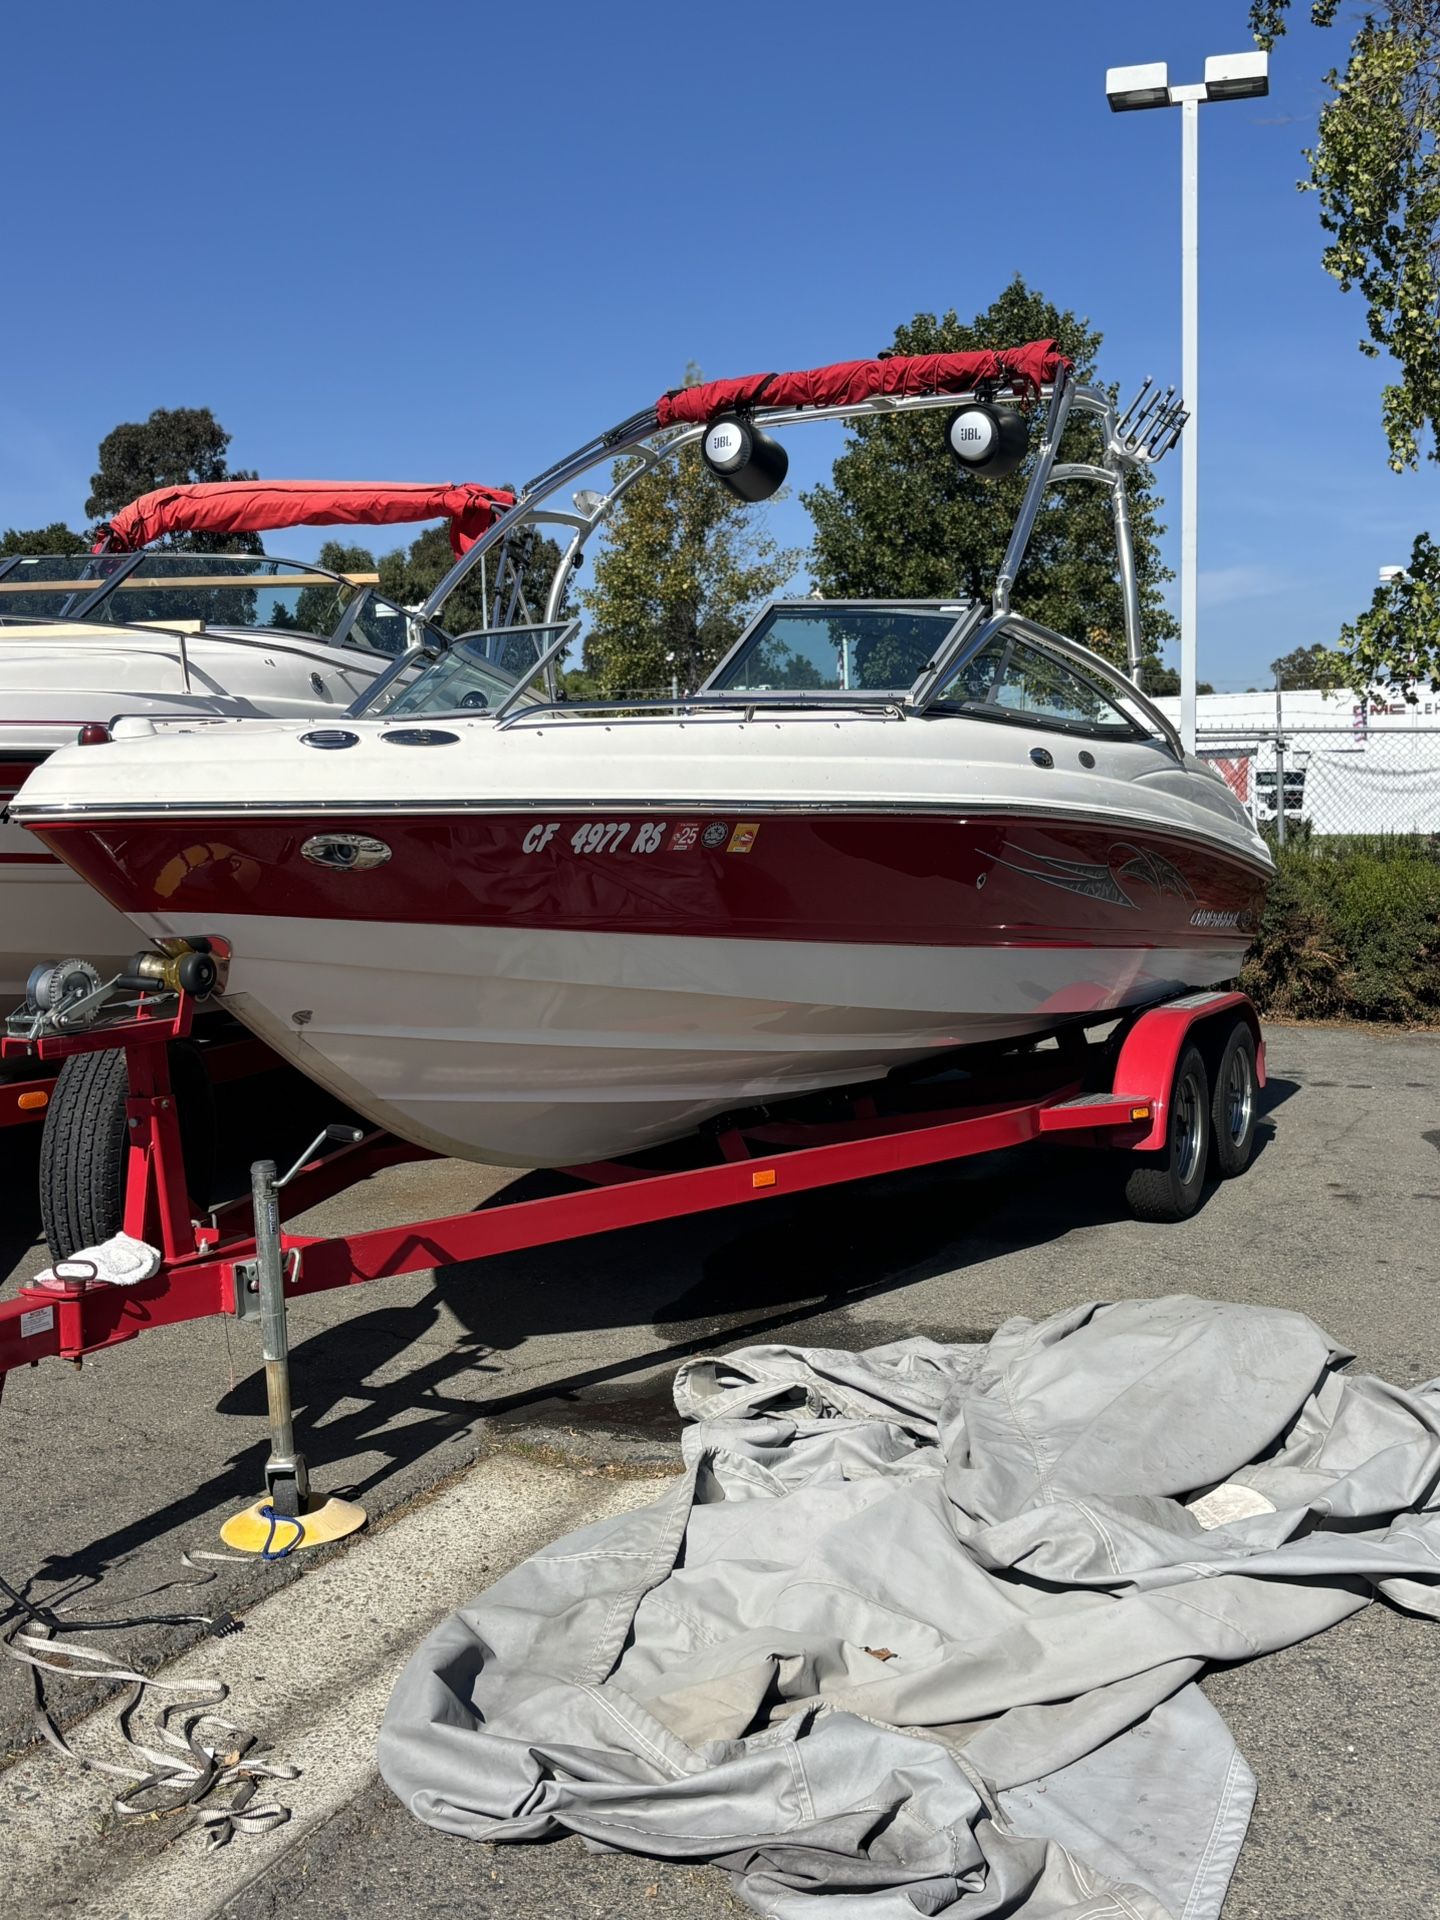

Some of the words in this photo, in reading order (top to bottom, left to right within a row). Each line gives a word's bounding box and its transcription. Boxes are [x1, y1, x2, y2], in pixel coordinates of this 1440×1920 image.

[714, 435, 732, 449] JBL
[960, 427, 981, 441] JBL
[522, 823, 560, 854] CF
[570, 823, 631, 854] 4977
[630, 822, 667, 853] RS
[678, 827, 700, 845] 25
